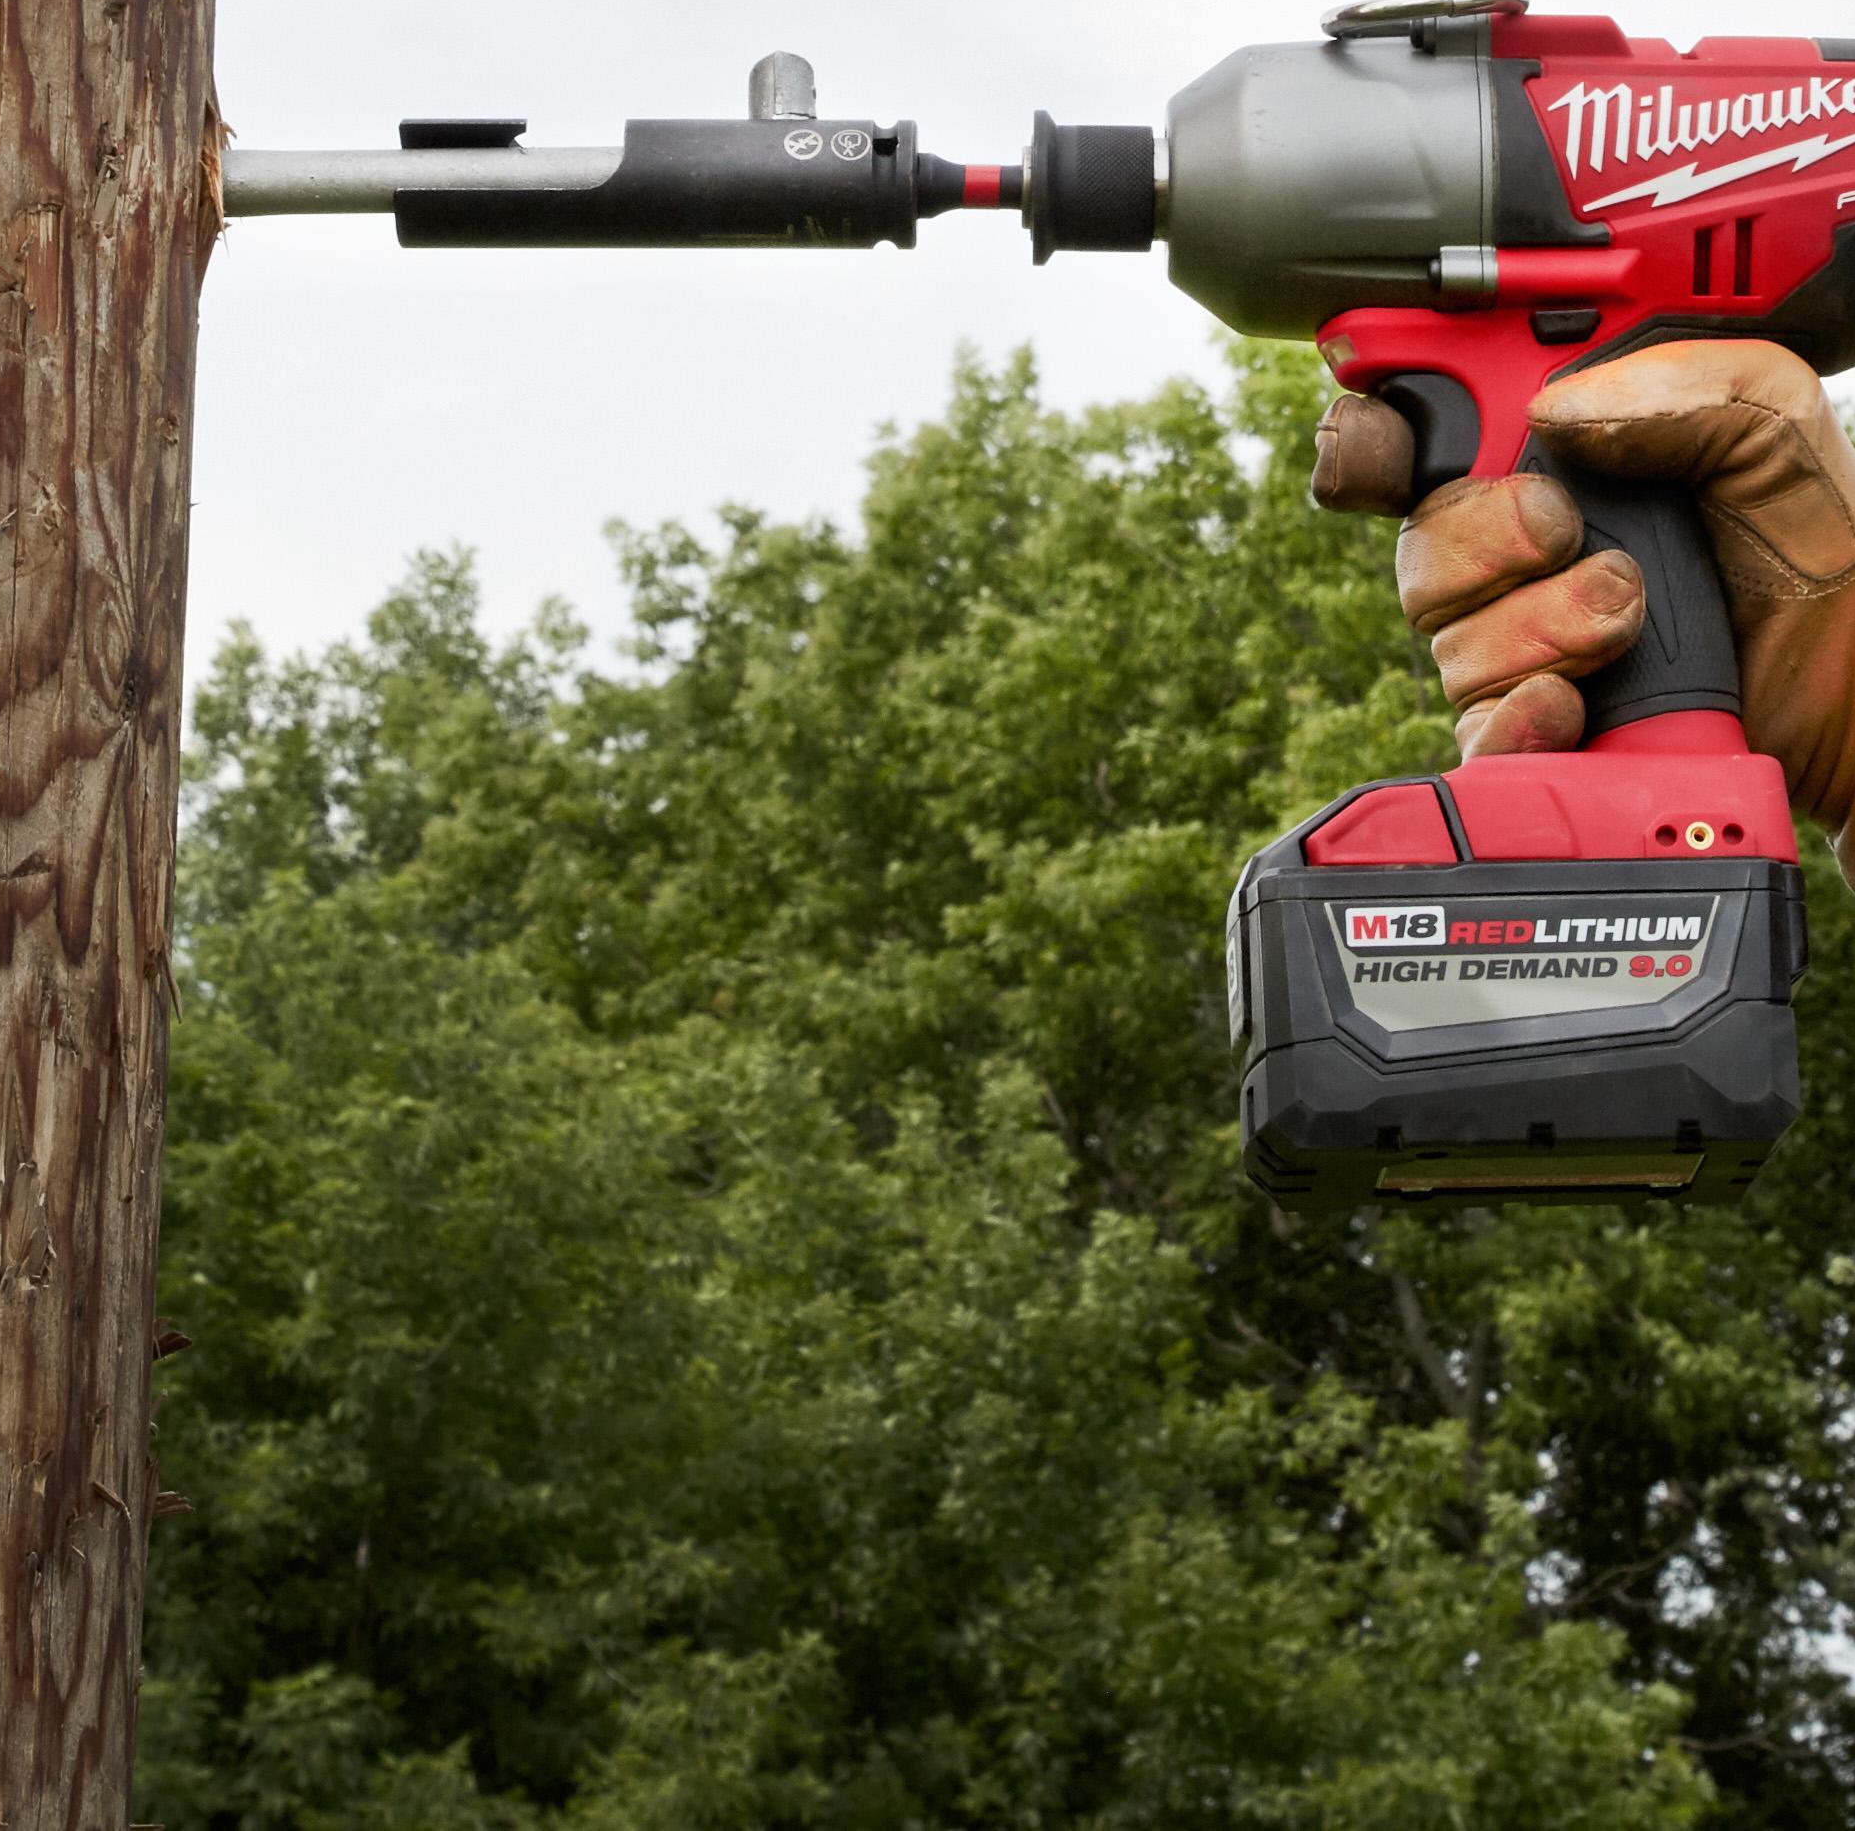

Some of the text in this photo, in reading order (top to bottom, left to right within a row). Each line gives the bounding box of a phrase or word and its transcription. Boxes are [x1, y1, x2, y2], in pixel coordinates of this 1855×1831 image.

[1353, 914, 1439, 941] M18
[1353, 954, 1693, 984] HIGH DEMAND 9.0
